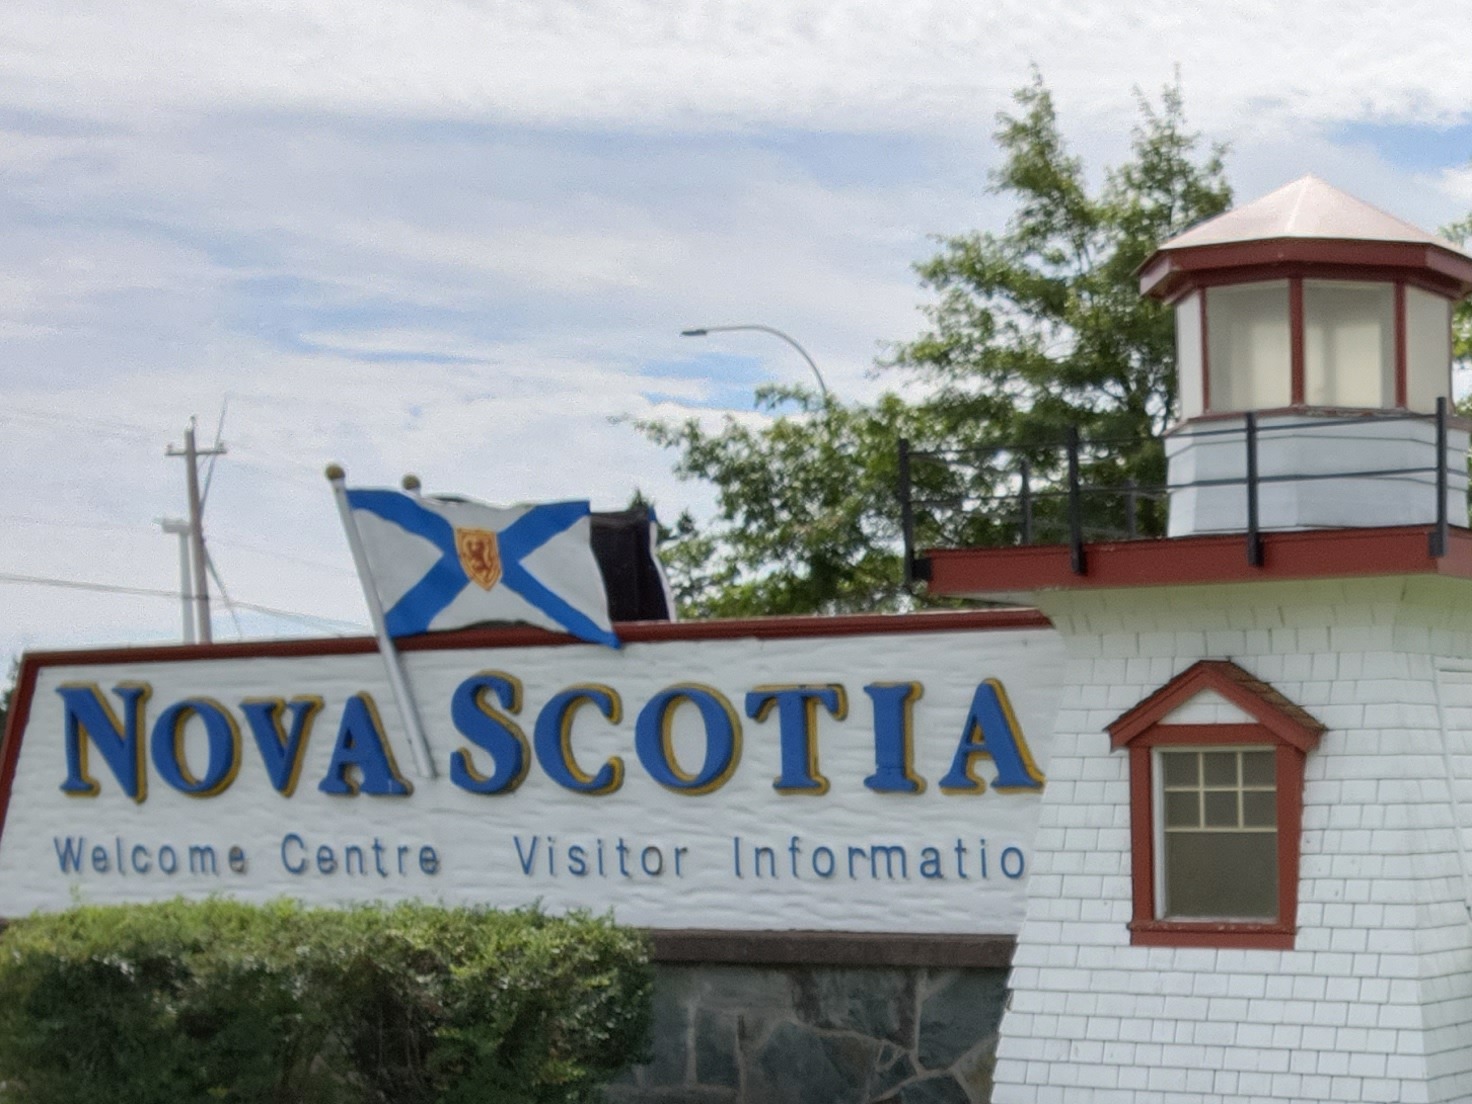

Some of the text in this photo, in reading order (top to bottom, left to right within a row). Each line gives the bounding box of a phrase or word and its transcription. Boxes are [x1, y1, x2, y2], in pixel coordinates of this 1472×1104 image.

[54, 669, 1047, 804] NOVA SCOTIA
[53, 833, 1027, 879] Welcome Centre Visitor Informatio
